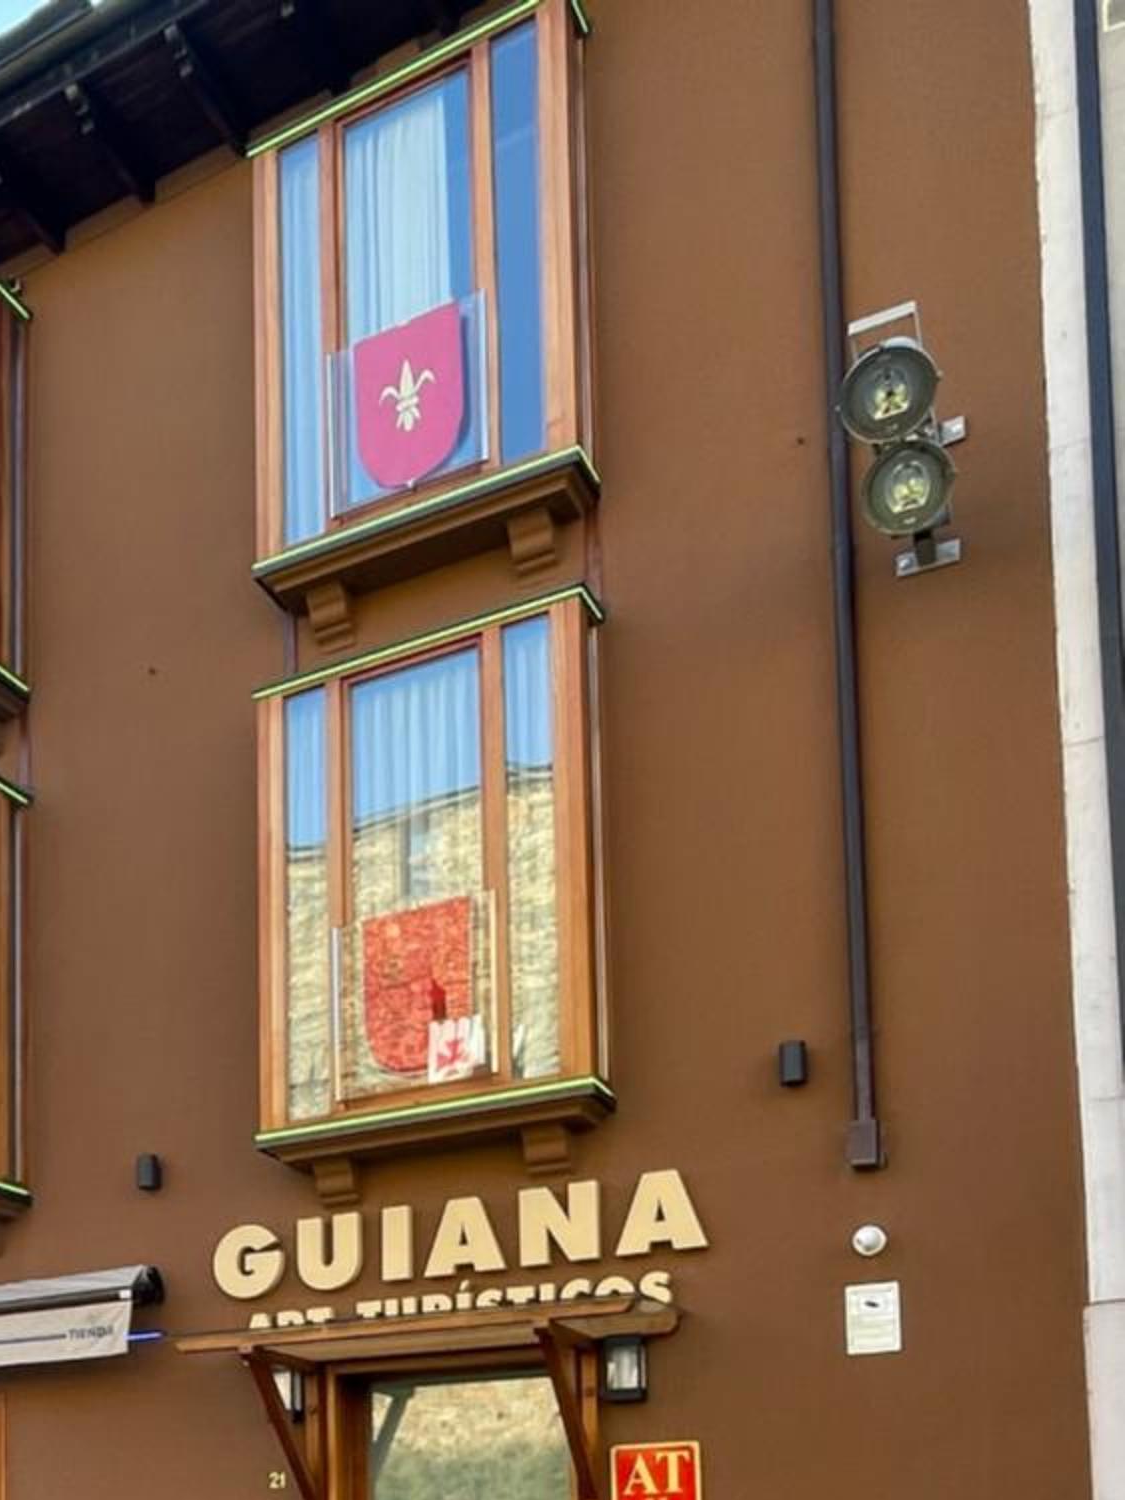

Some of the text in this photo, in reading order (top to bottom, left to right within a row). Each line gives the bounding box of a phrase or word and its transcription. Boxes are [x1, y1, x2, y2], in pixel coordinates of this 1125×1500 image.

[213, 1168, 708, 1300] GUIANA
[268, 1471, 286, 1489] 21
[623, 1450, 691, 1496] AT
